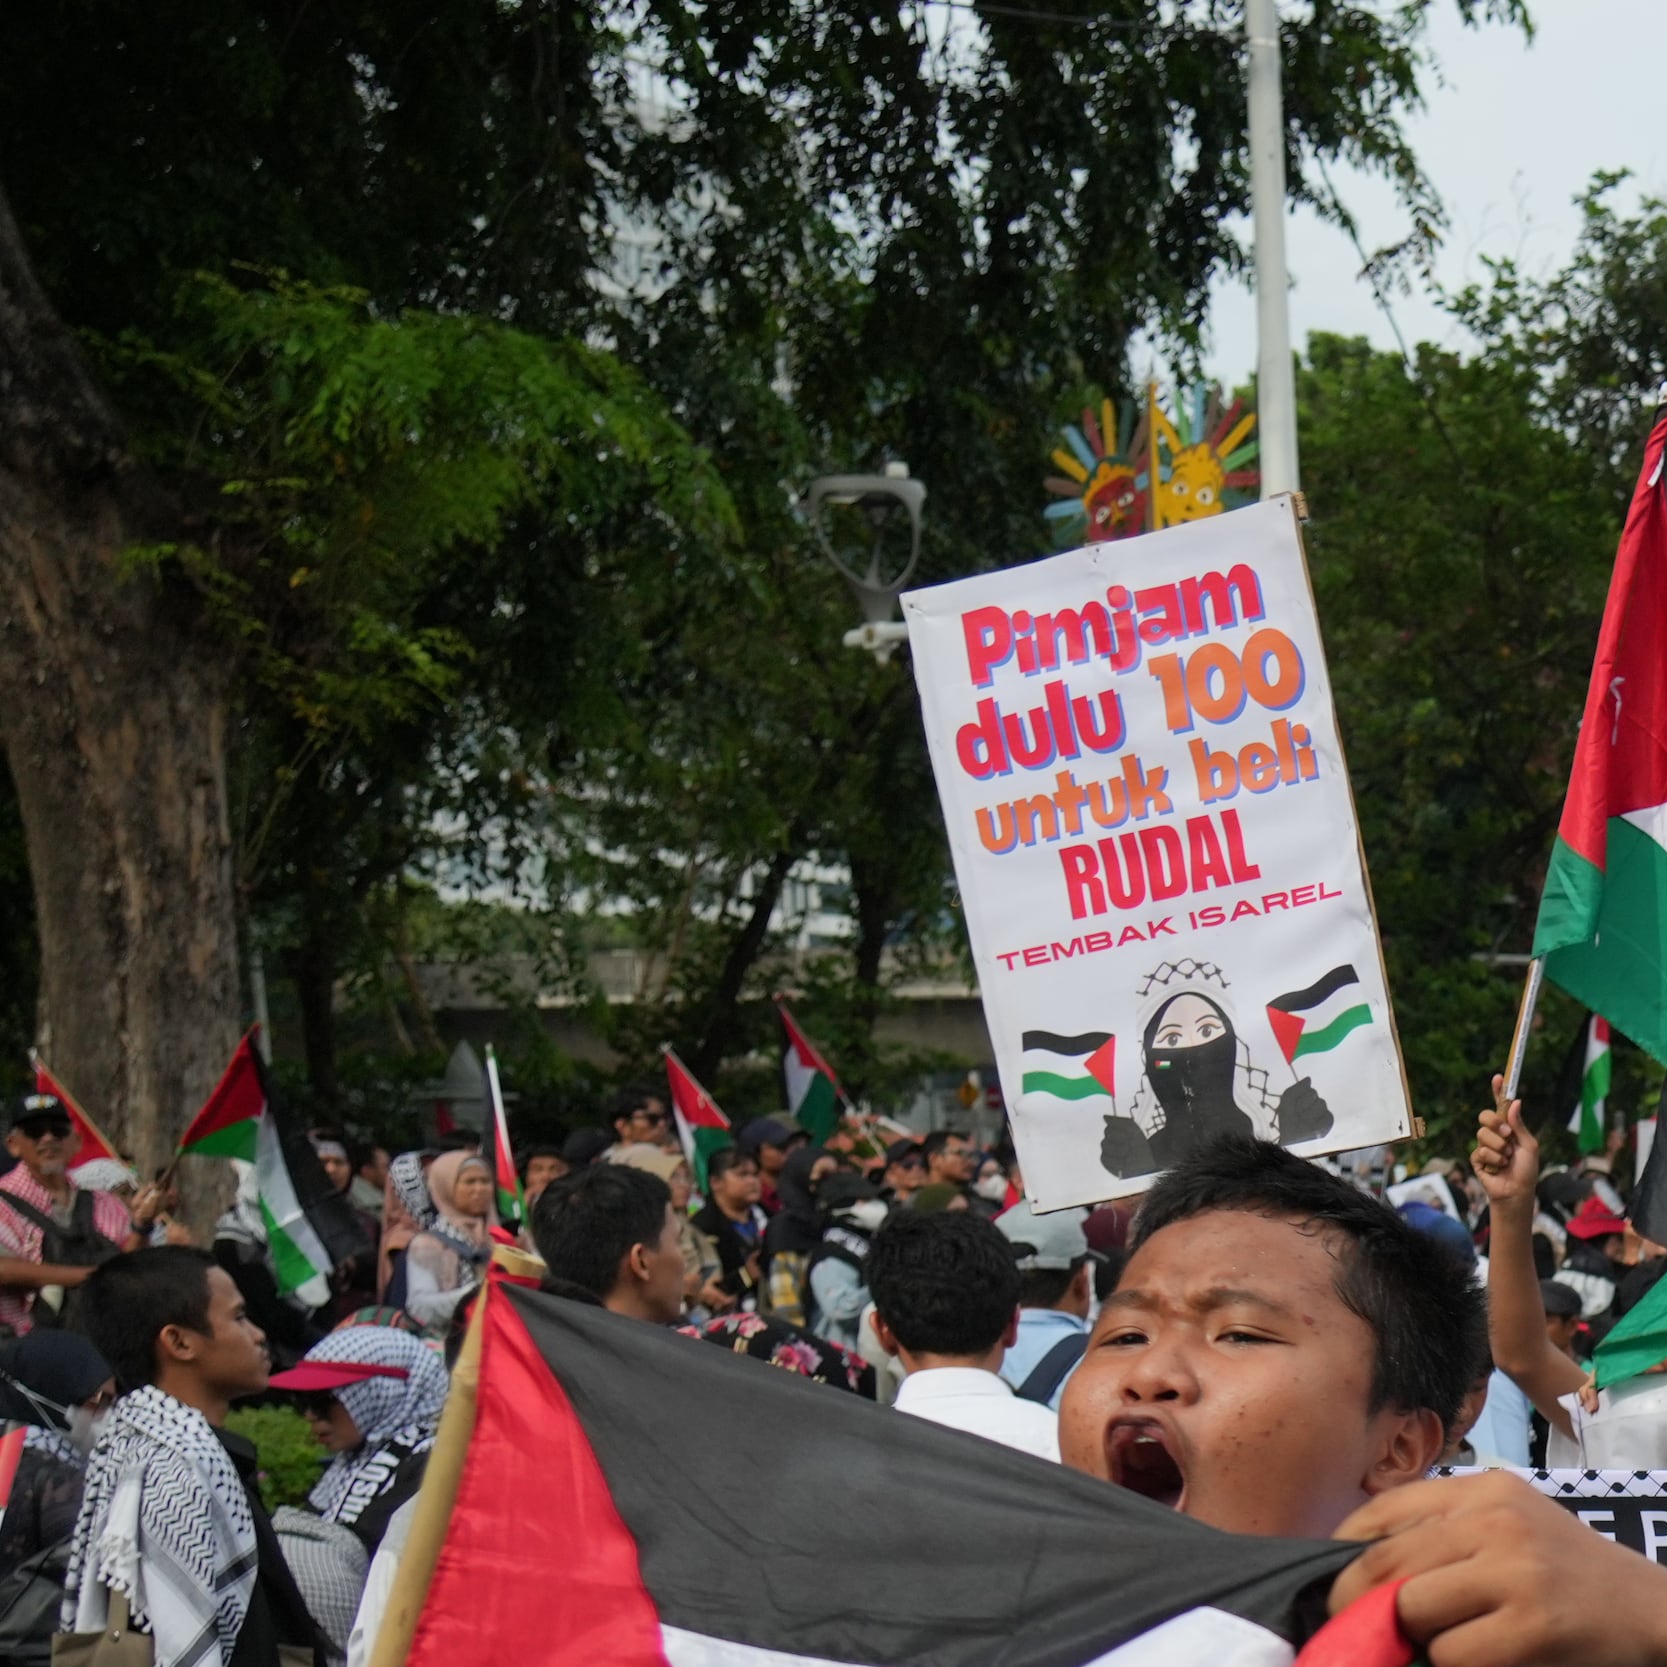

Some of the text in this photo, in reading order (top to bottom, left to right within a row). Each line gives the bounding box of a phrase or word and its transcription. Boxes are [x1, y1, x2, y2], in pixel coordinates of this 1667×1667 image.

[962, 563, 1265, 688] Pimjam
[956, 628, 1305, 781] dulu 100
[975, 718, 1320, 855] untuk beli
[1059, 808, 1260, 919] RUDAL
[997, 882, 1342, 971] TEMBAK ISAREL
